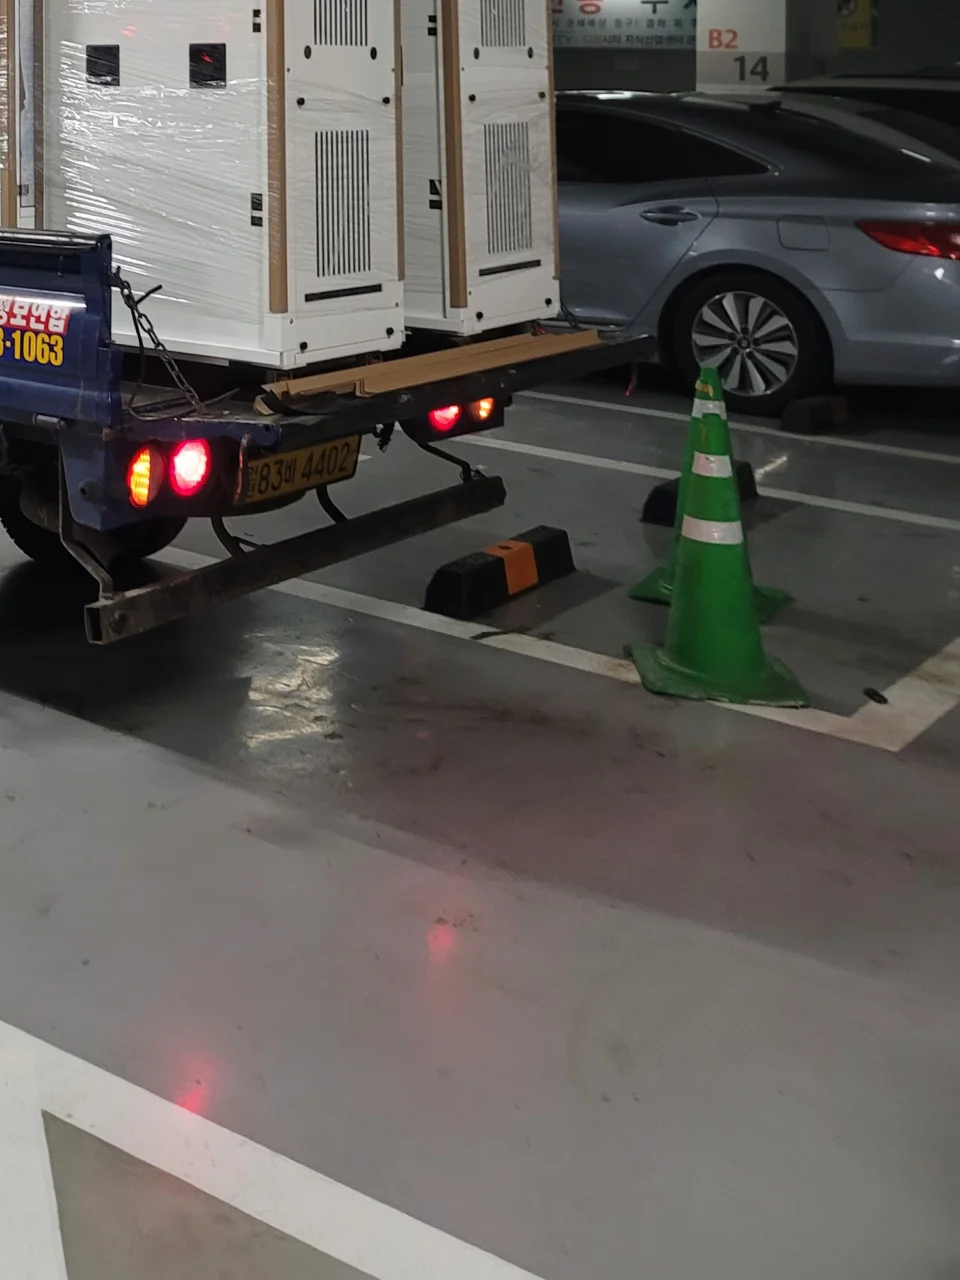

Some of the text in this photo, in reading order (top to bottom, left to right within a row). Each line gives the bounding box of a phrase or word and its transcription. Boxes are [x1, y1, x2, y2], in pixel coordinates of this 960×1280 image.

[708, 29, 738, 49] B2
[733, 55, 770, 82] 14
[301, 442, 350, 481] 4402
